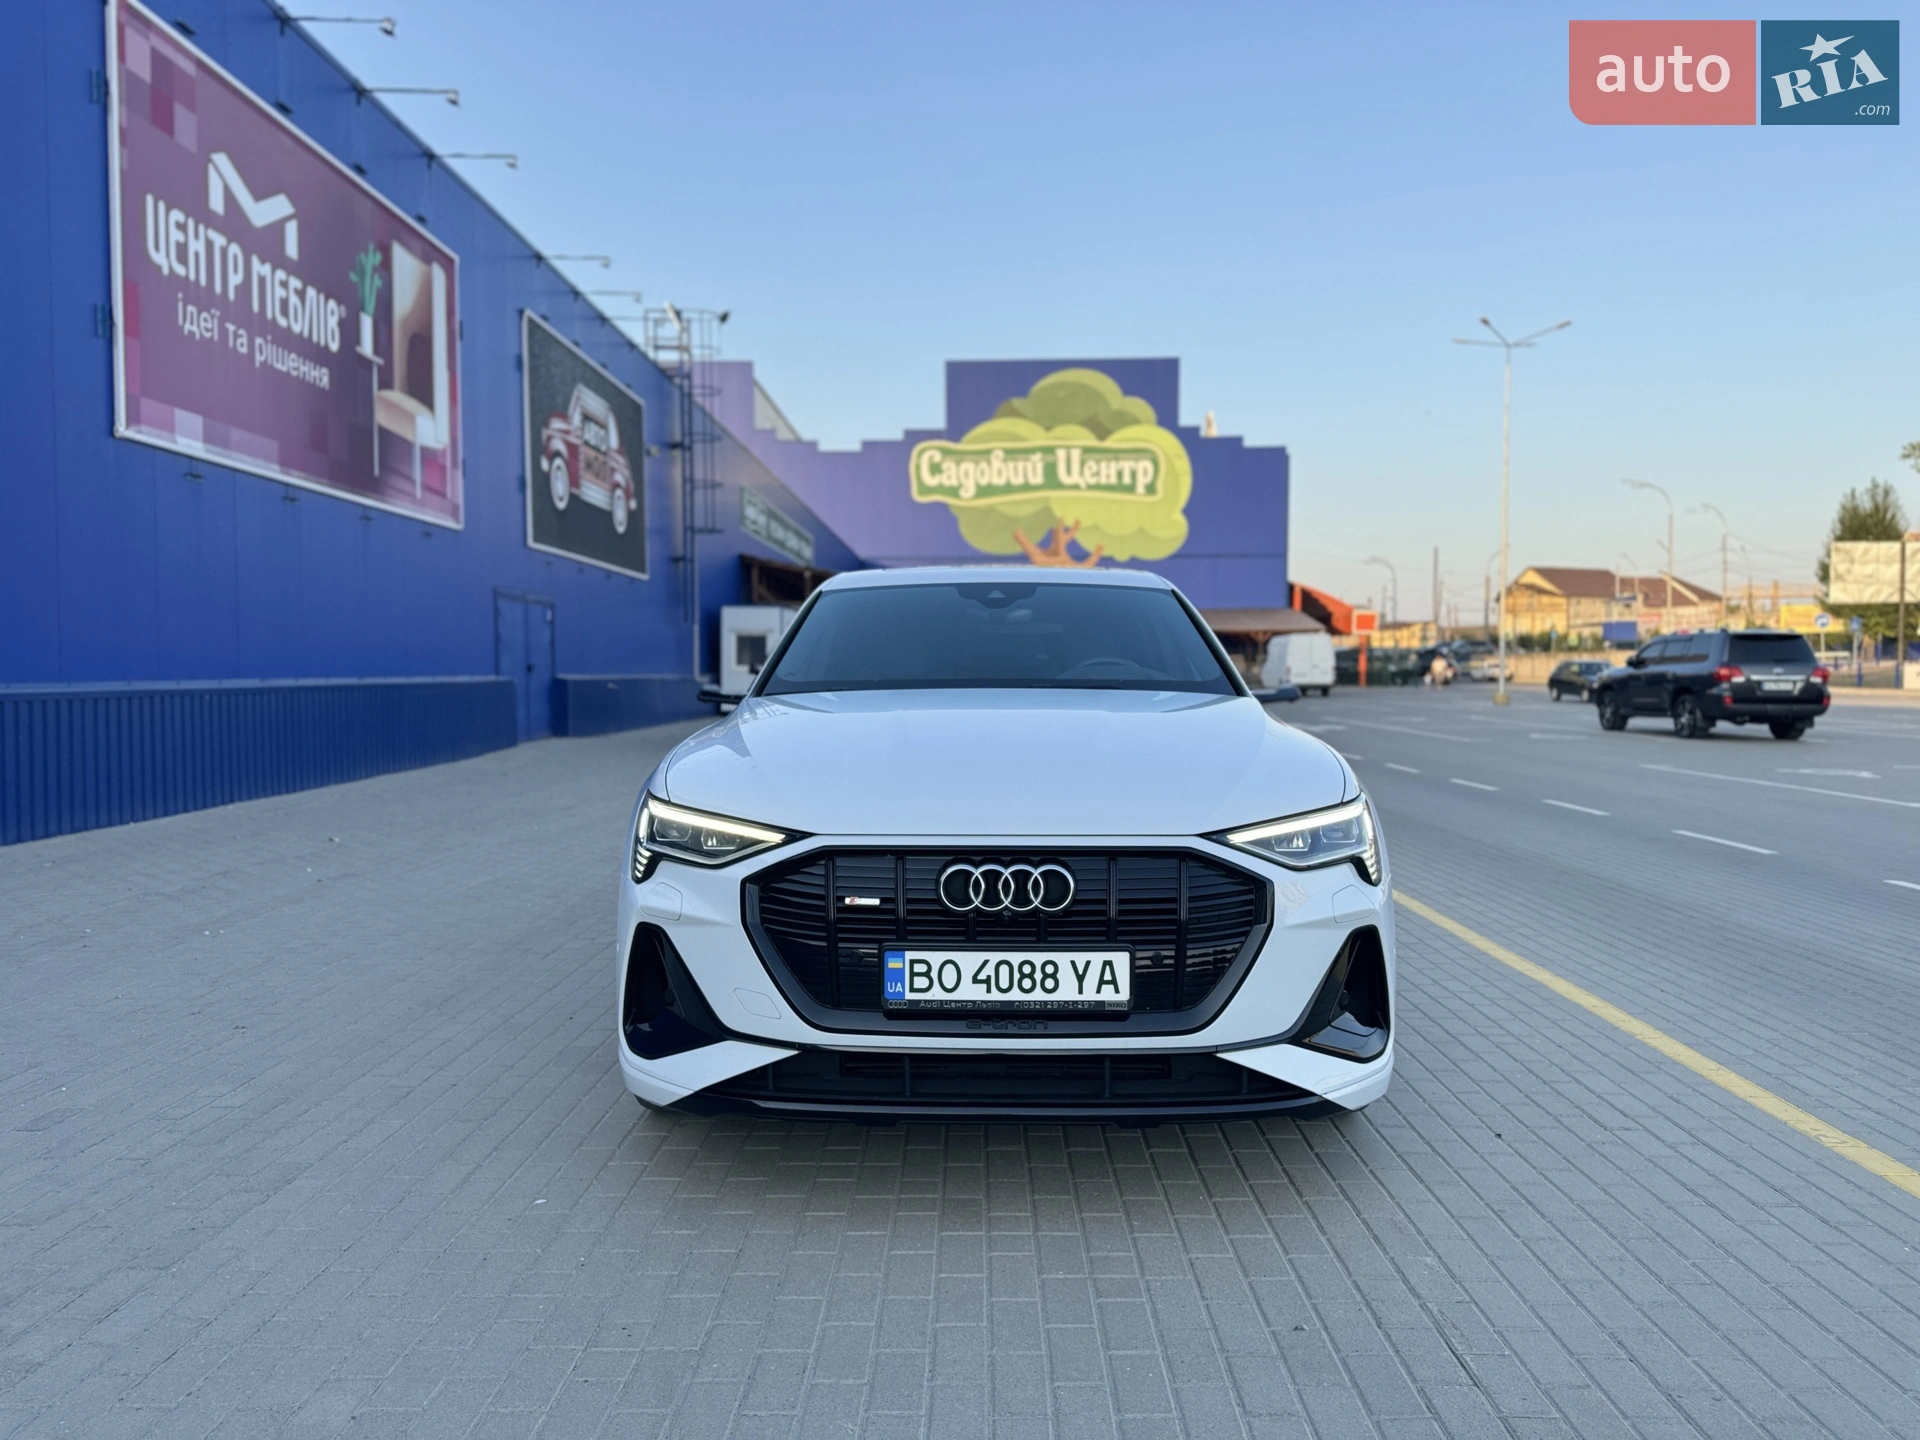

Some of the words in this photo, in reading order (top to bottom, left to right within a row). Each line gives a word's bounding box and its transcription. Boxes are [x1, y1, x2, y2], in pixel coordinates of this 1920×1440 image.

[145, 193, 244, 302] ЦЕНТР
[177, 293, 221, 342] ідеї
[225, 320, 248, 354] та
[254, 333, 331, 390] рішення
[919, 448, 1044, 499] Садовий
[1055, 447, 1155, 495] Центр
[887, 981, 904, 994] UA
[971, 958, 1060, 994] 4088
[1069, 959, 1121, 995] YA
[919, 1000, 940, 1008] Audi
[943, 1000, 973, 1009] Центр
[1046, 1001, 1095, 1009] 297-1-297
